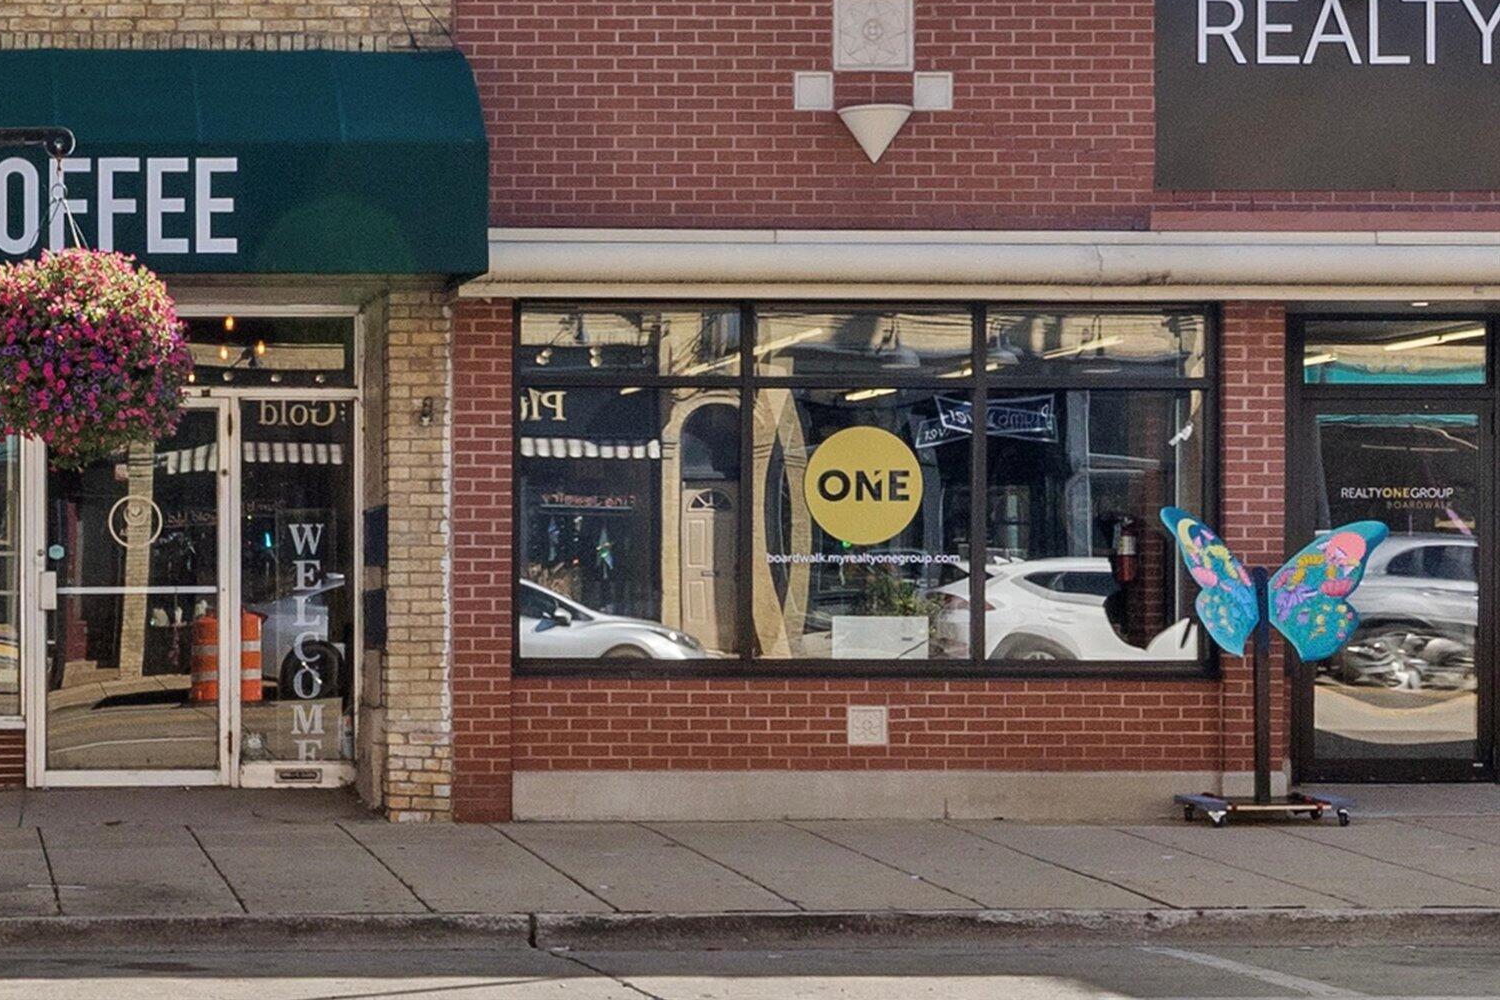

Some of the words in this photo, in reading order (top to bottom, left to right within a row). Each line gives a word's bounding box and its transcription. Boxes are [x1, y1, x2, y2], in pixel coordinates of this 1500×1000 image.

[817, 469, 911, 502] ONE
[766, 552, 961, 565] boardwalk.myrealtyonegroup.com
[288, 523, 325, 761] WELCOME
